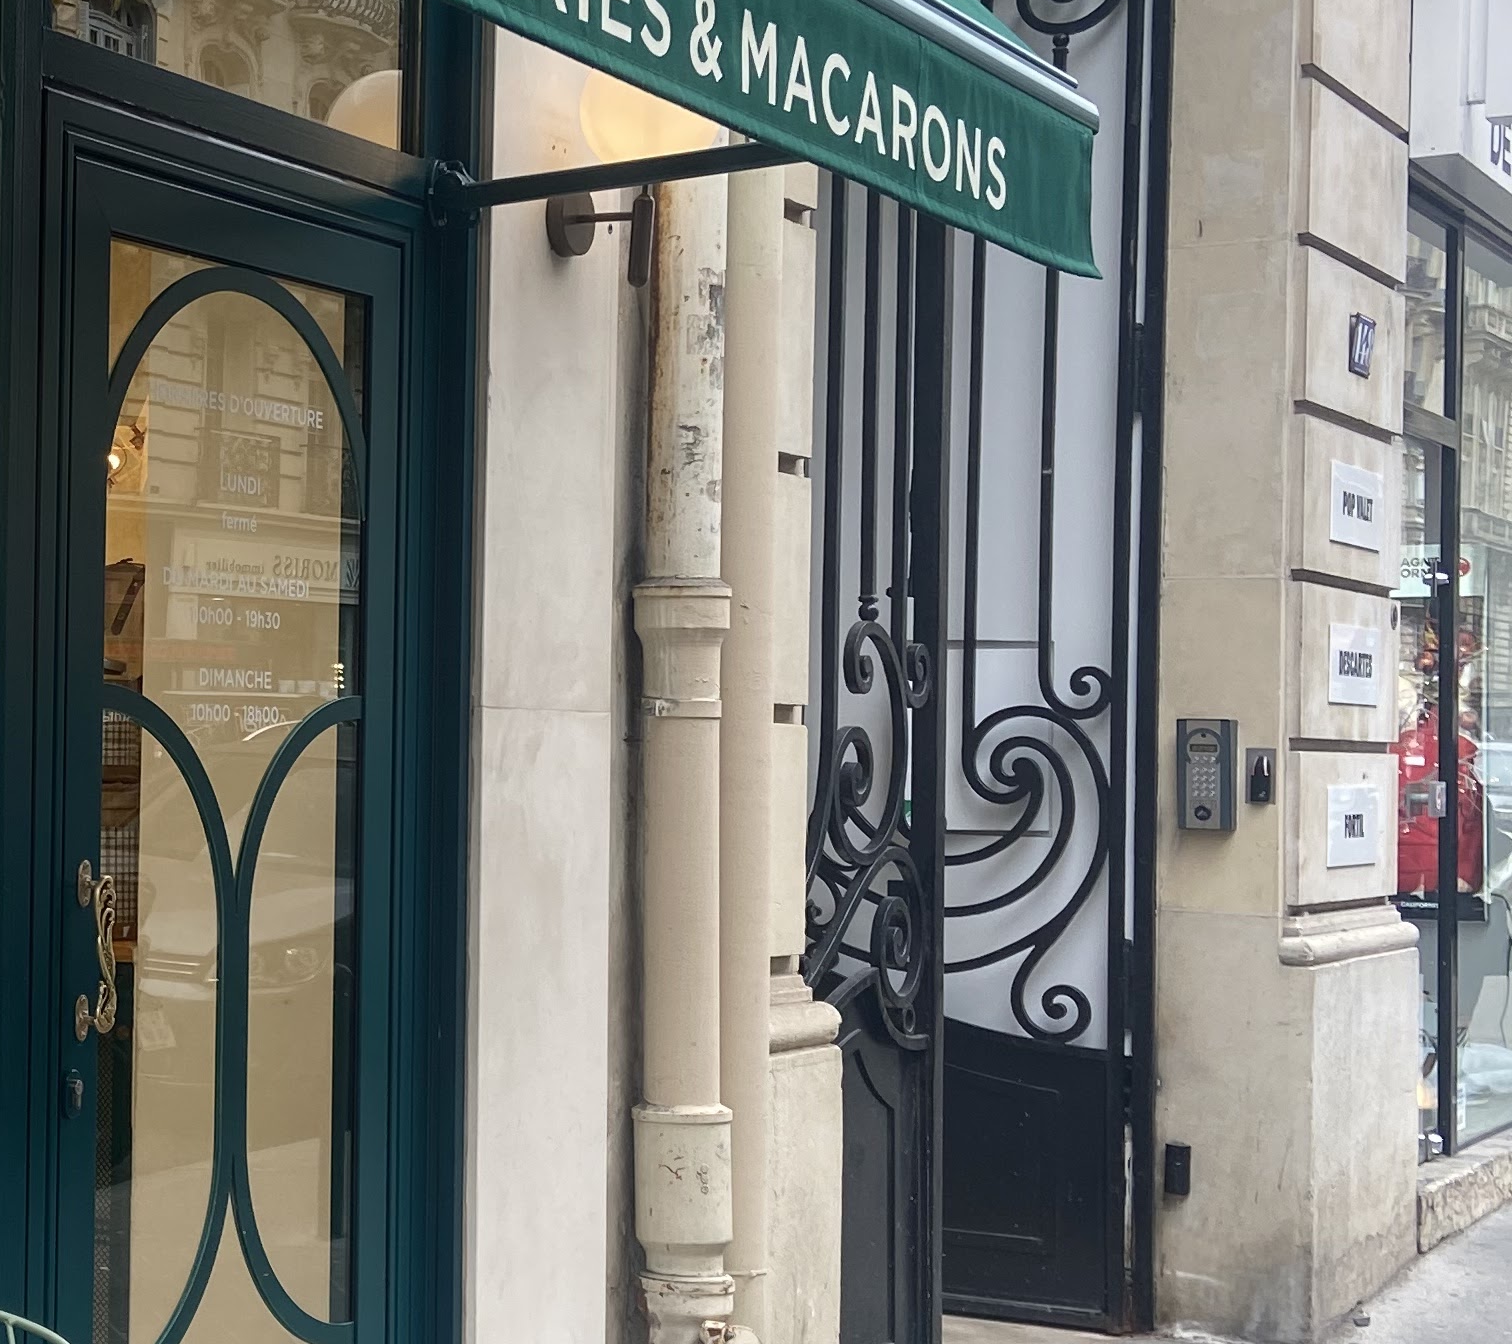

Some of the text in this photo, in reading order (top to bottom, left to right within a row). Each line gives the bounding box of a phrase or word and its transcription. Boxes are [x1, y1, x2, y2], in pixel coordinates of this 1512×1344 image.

[739, 8, 1010, 212] MACARONS
[229, 393, 325, 431] D'OUVERTURE
[220, 471, 262, 496] LUNDI
[221, 510, 258, 533] fermé
[238, 574, 257, 594] AU
[260, 577, 310, 599] SAMEDI
[245, 609, 281, 630] 19h30
[199, 667, 273, 690] DIMANCHE
[191, 703, 231, 723] 10h00
[242, 704, 280, 724] 18h00
